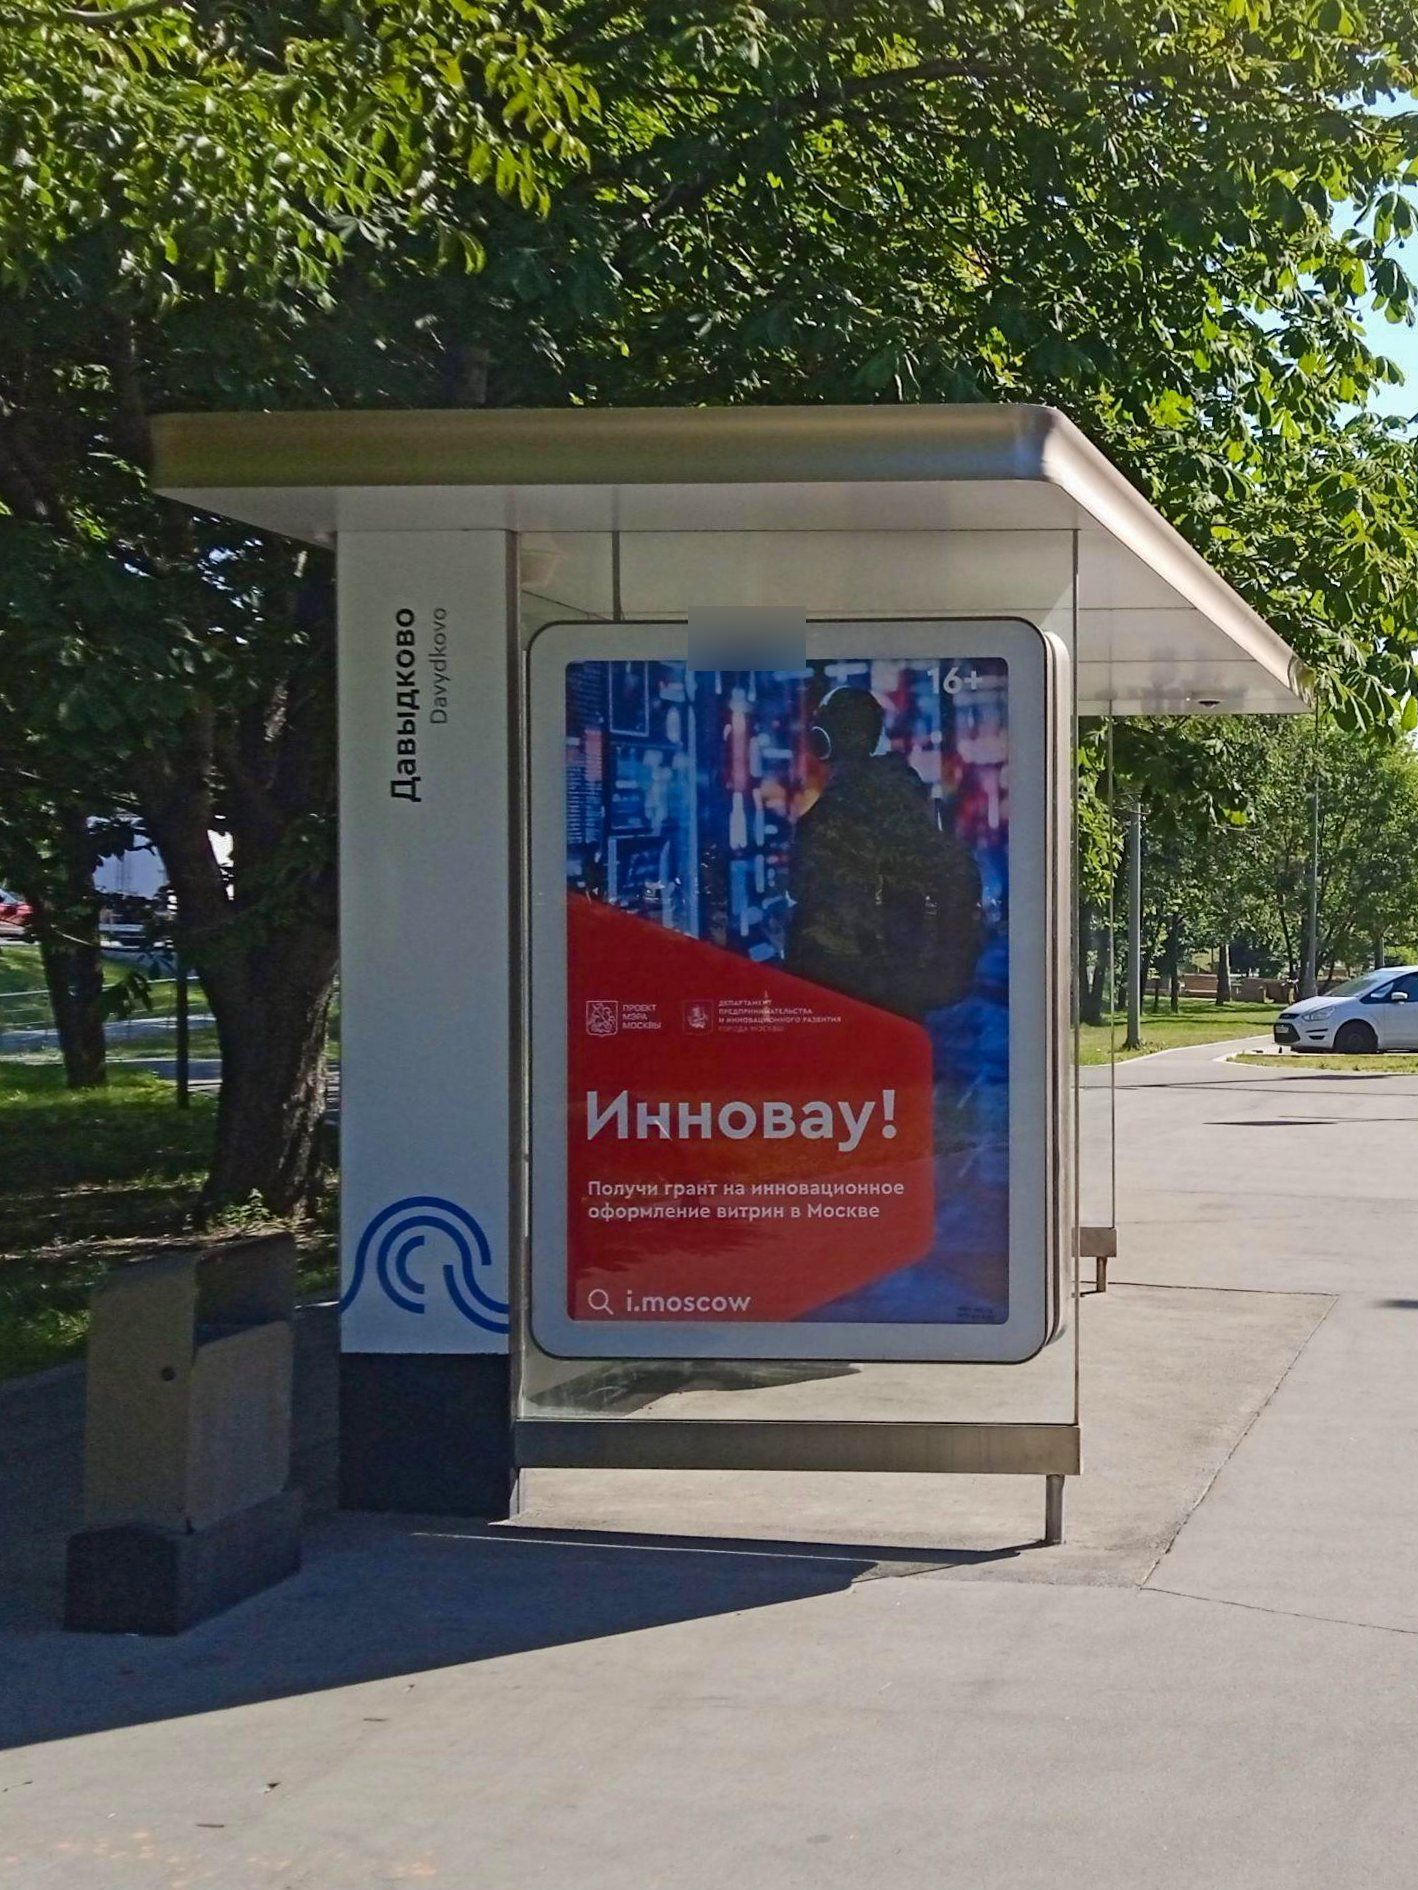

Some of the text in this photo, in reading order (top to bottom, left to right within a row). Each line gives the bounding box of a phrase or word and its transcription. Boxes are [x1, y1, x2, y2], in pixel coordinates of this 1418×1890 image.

[428, 607, 450, 724] Davydkovo
[927, 667, 982, 694] 16+
[390, 608, 422, 802] Давыдково
[622, 1004, 657, 1012] ПРОЕКТ
[622, 1013, 648, 1021] МЭРА
[622, 1021, 662, 1030] МОСКВЫ
[587, 1089, 897, 1152] Инновау!
[588, 1181, 904, 1200] Получи грант на инновационное
[588, 1203, 880, 1222] оформление витрин в Москве
[626, 1289, 752, 1313] i.moscow
